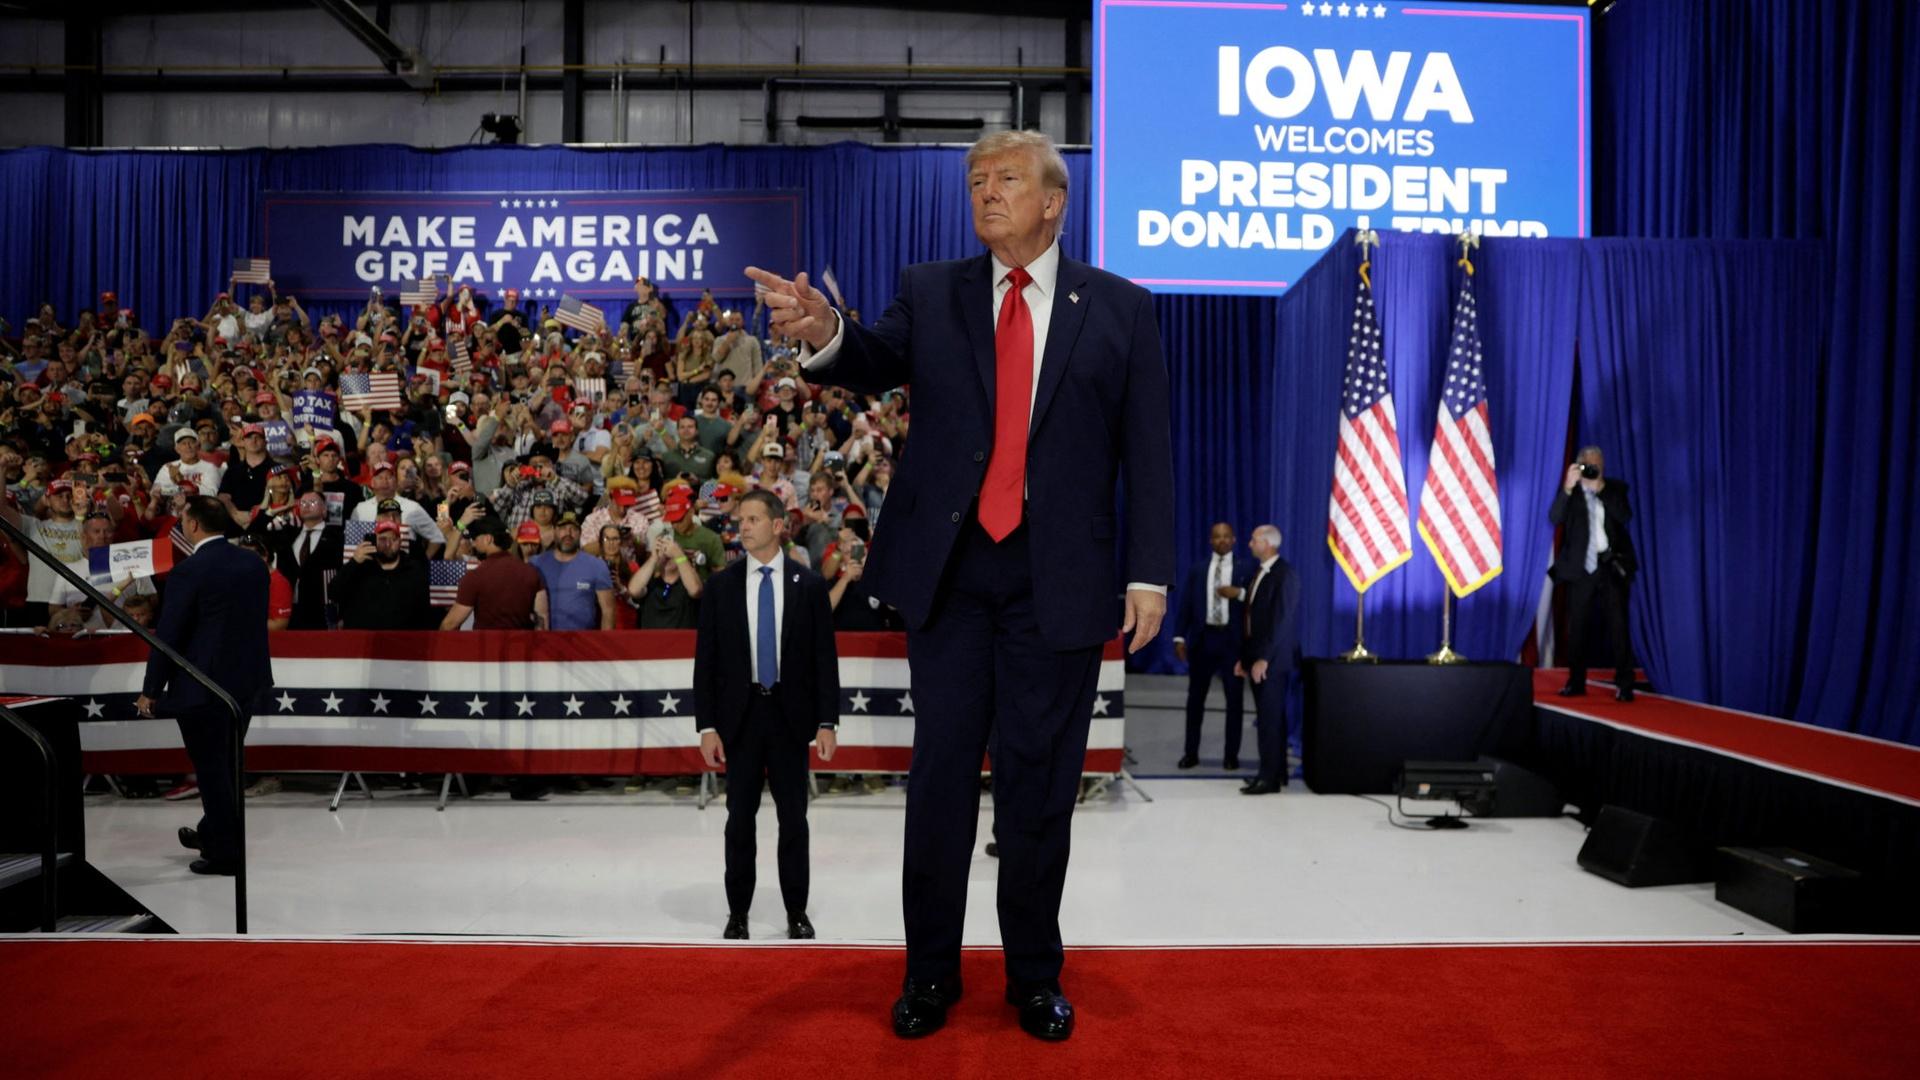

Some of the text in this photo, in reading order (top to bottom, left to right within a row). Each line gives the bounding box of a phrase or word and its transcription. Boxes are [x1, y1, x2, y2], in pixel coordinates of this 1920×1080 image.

[1218, 45, 1474, 124] IOWA
[1254, 124, 1434, 157] WELCOMES
[1181, 159, 1508, 214] PRESIDENT
[342, 213, 720, 248] MAKE AMERICA
[1137, 210, 1335, 251] DONALD
[354, 248, 704, 283] GREAT AGAIN!
[293, 396, 331, 409] NO TAX
[264, 426, 286, 436] TAX
